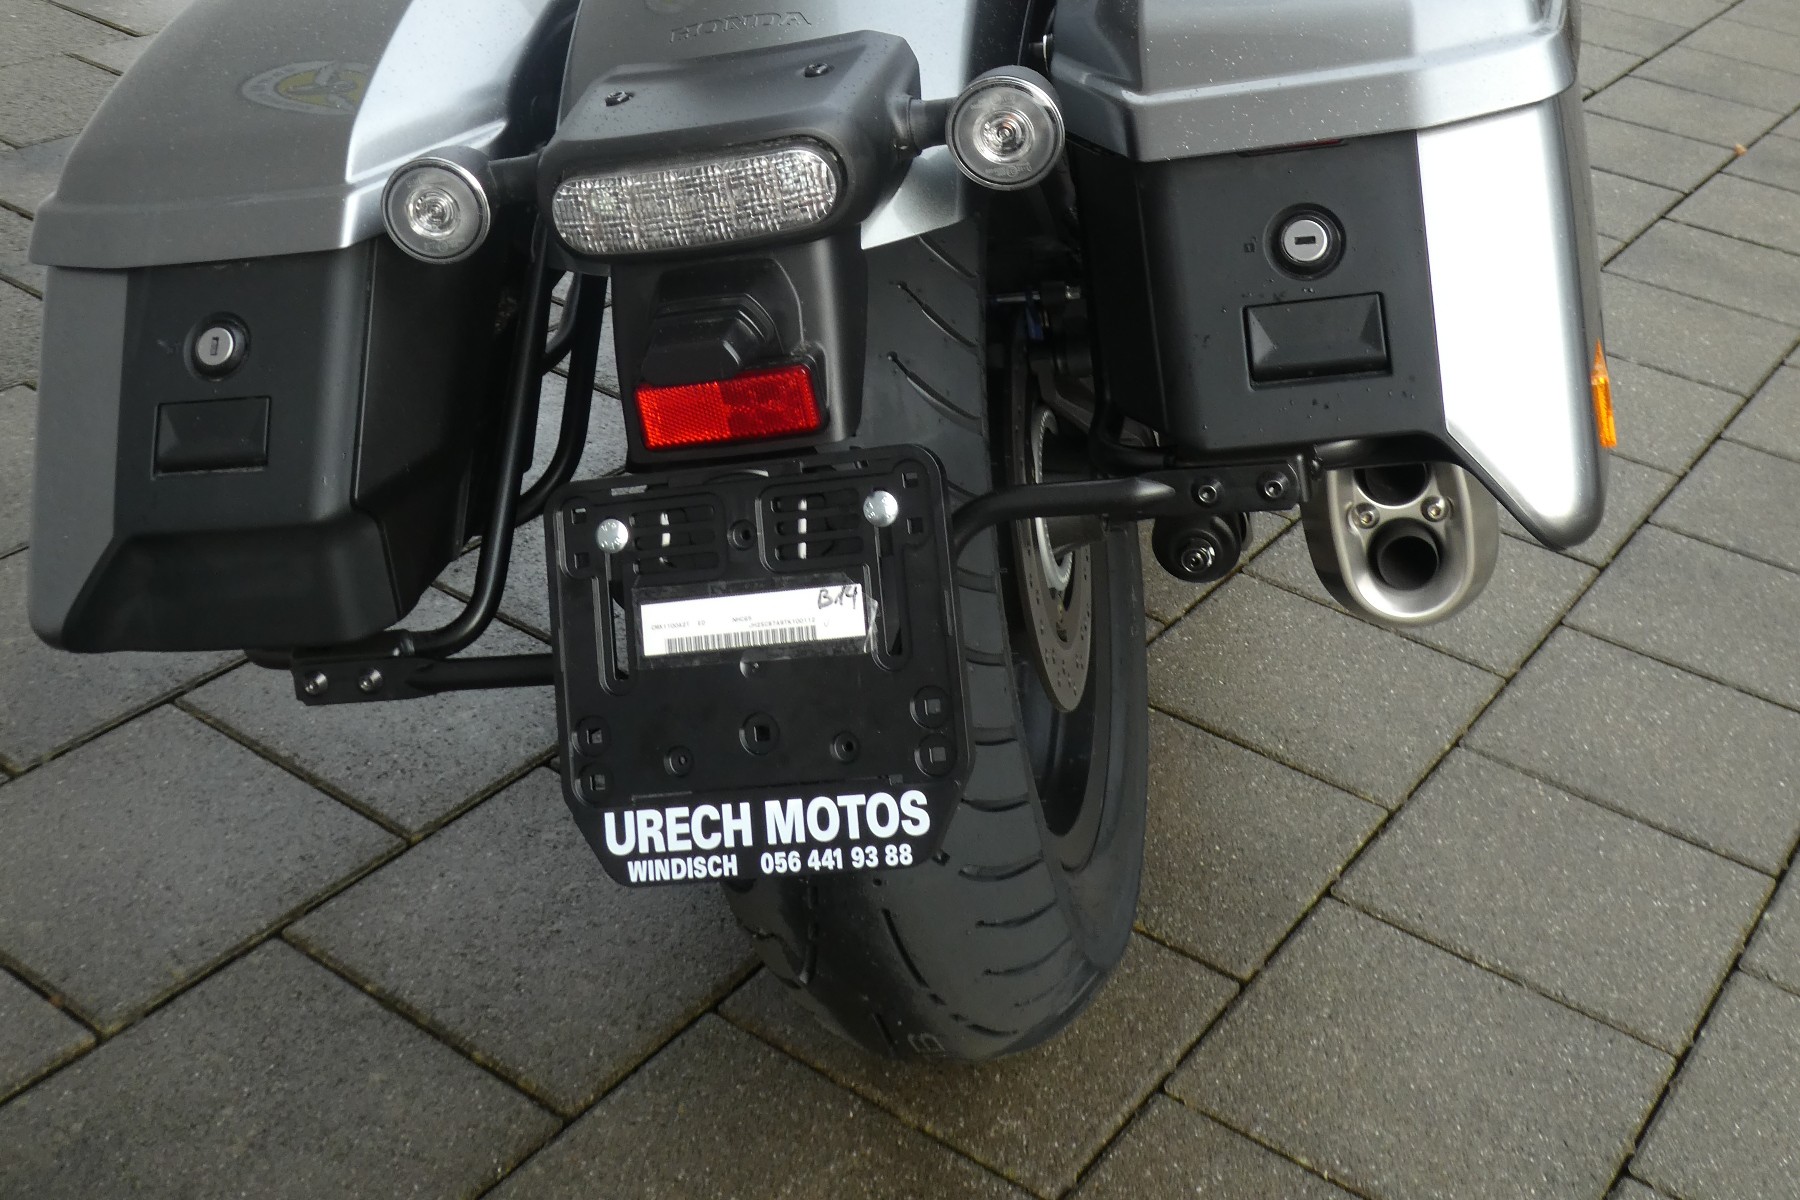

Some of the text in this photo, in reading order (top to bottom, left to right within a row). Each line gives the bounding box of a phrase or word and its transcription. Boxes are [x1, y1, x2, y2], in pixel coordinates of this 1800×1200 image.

[669, 11, 812, 43] HONDA
[604, 789, 931, 856] URECH MOTOS
[627, 843, 914, 883] WINDISCH 056 441 93 88
